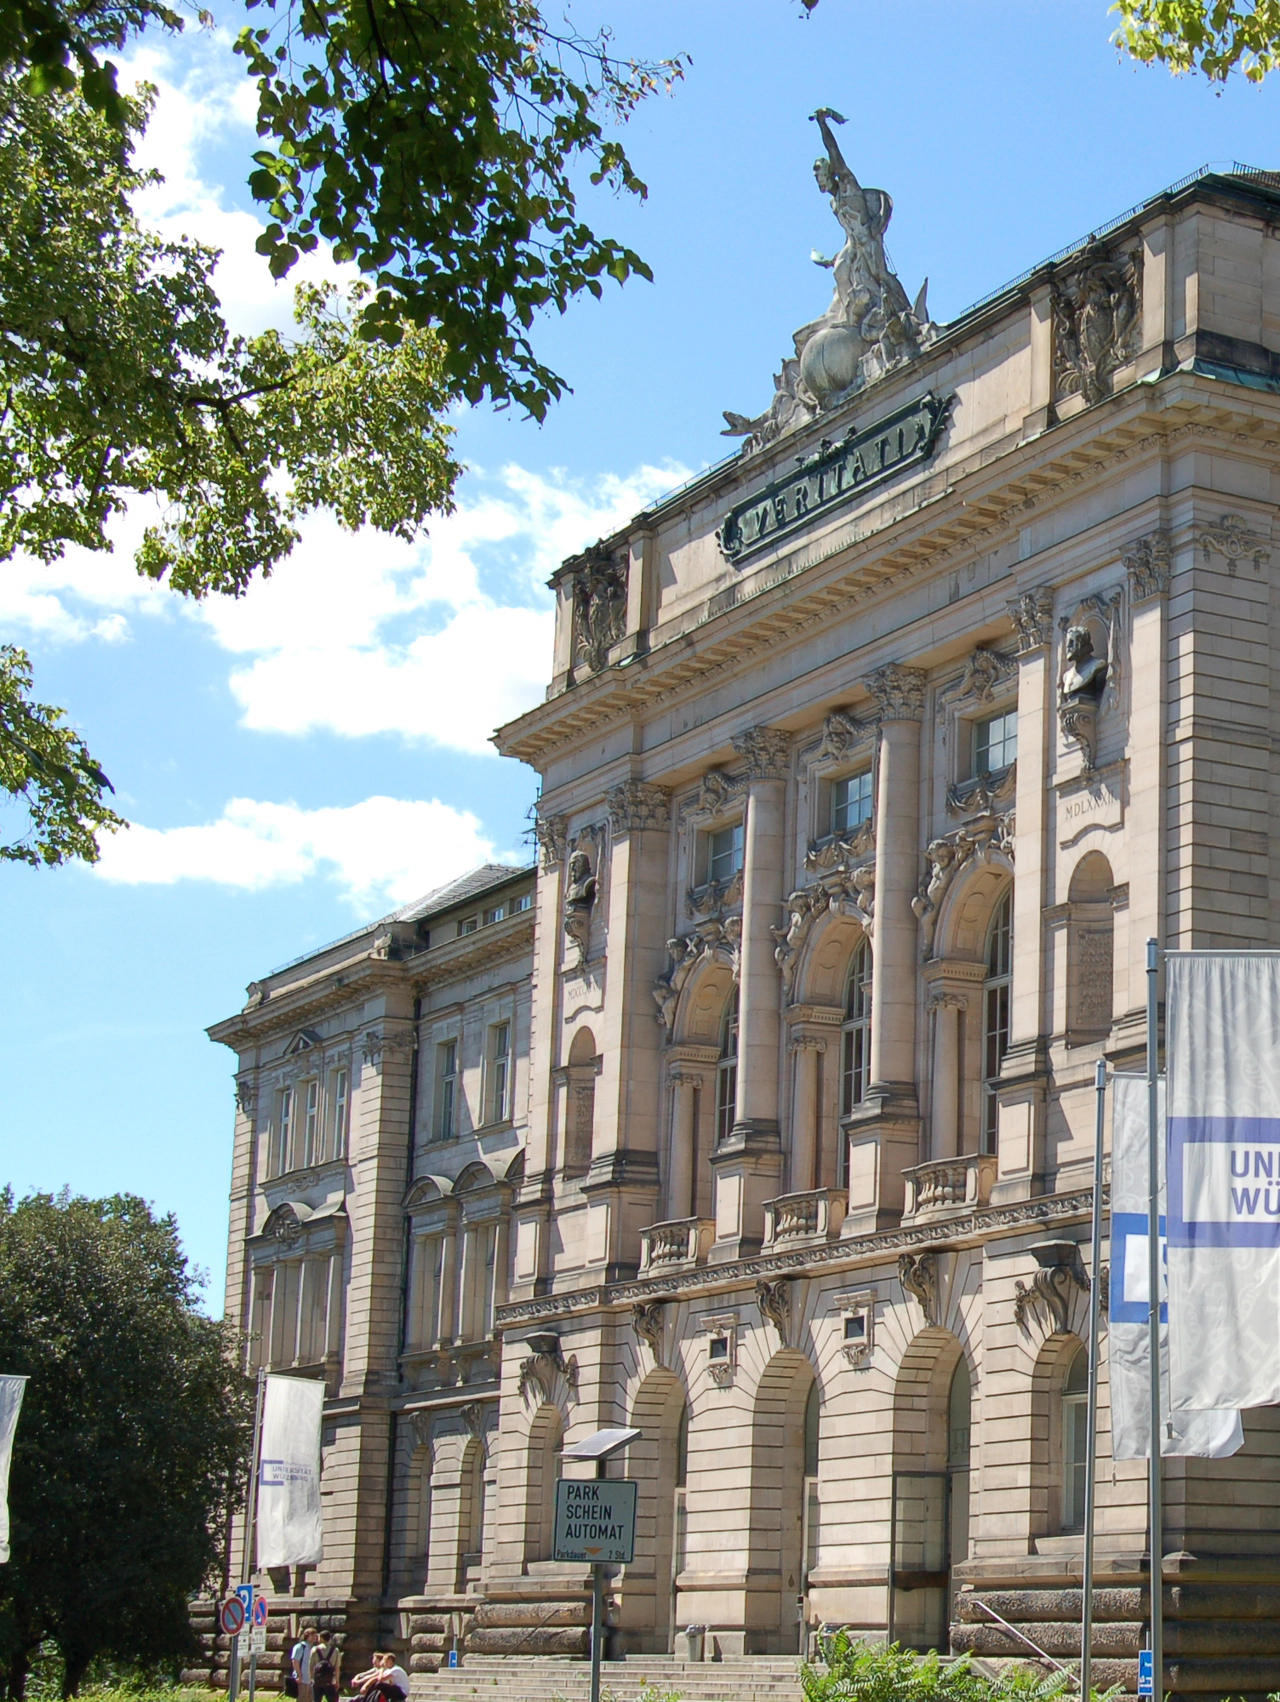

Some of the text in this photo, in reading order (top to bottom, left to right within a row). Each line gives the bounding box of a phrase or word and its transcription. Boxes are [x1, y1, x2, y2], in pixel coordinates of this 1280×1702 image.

[754, 426, 905, 536] VERITATI
[272, 1465, 312, 1476] UNIERSITÄT
[567, 1485, 600, 1501] PARK
[566, 1504, 612, 1520] SCHEIN
[565, 1523, 624, 1540] AUTOMAT
[556, 1549, 587, 1559] Parkdauer
[608, 1550, 613, 1560] 2
